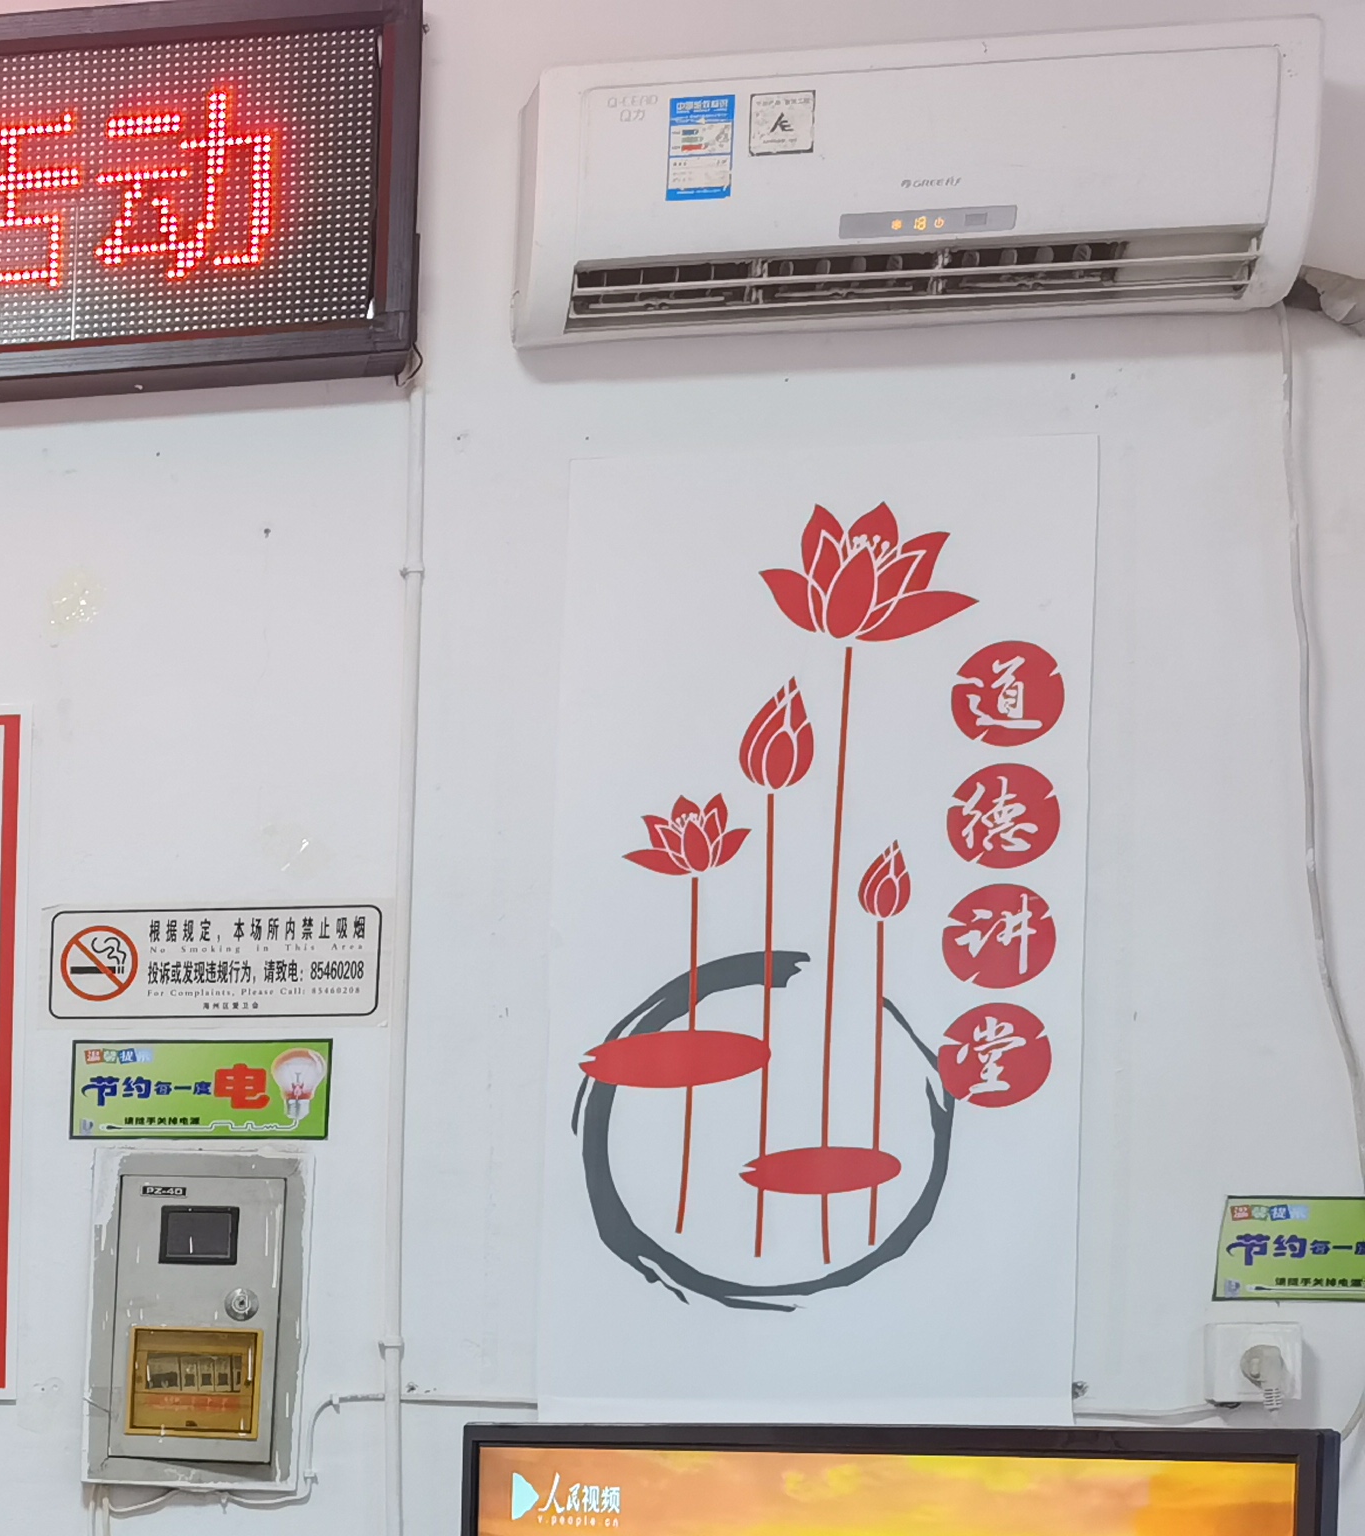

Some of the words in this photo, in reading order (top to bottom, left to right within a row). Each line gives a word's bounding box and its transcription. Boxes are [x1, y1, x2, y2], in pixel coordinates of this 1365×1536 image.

[954, 658, 1043, 1096] 道德讲堂
[149, 915, 367, 943] 根据规定，本场所内禁止吸烟
[150, 945, 166, 954] No
[180, 944, 242, 955] Smoking
[284, 943, 316, 952] This
[331, 942, 364, 951] Area
[147, 988, 165, 997] For
[241, 987, 275, 996] Please
[81, 1063, 270, 1109] 节约每一度电
[538, 1472, 621, 1513] 人民视频
